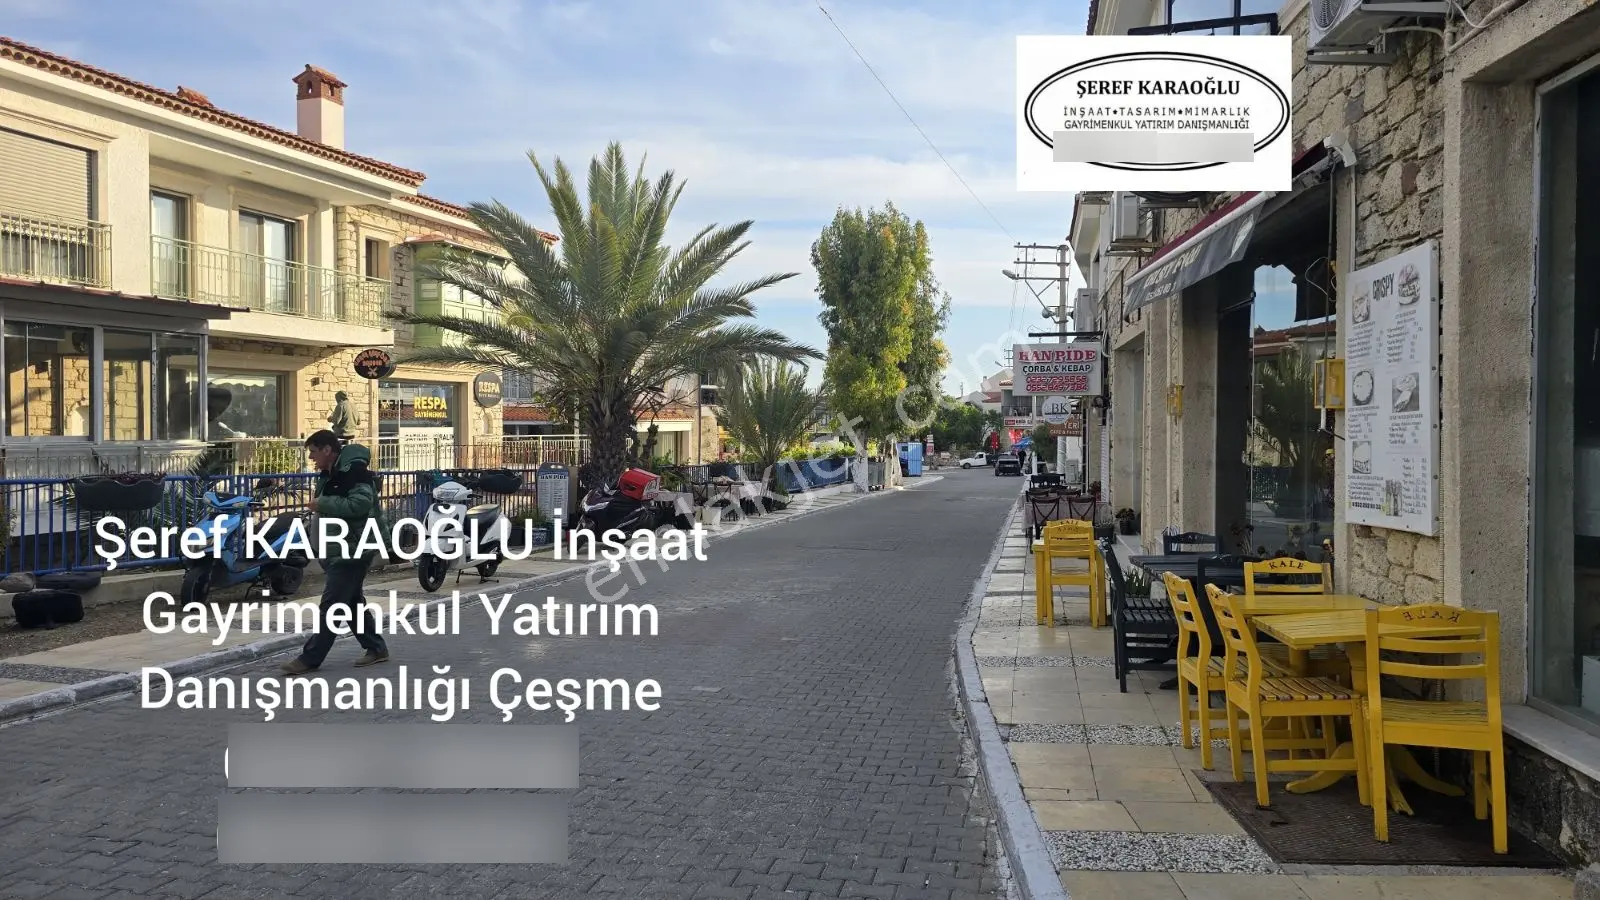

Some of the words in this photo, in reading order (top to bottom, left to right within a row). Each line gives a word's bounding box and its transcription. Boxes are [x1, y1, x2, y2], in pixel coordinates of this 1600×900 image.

[1372, 273, 1395, 302] CRISPY
[1018, 350, 1053, 362] HAN
[1055, 346, 1097, 362] PİDE
[1022, 365, 1052, 375] ÇORBA
[1053, 364, 1061, 373] &
[1061, 364, 1092, 373] KEBAP
[478, 381, 501, 394] RESPA
[414, 396, 448, 410] RESPA
[1051, 402, 1070, 415] BK
[1268, 560, 1305, 570] KALE
